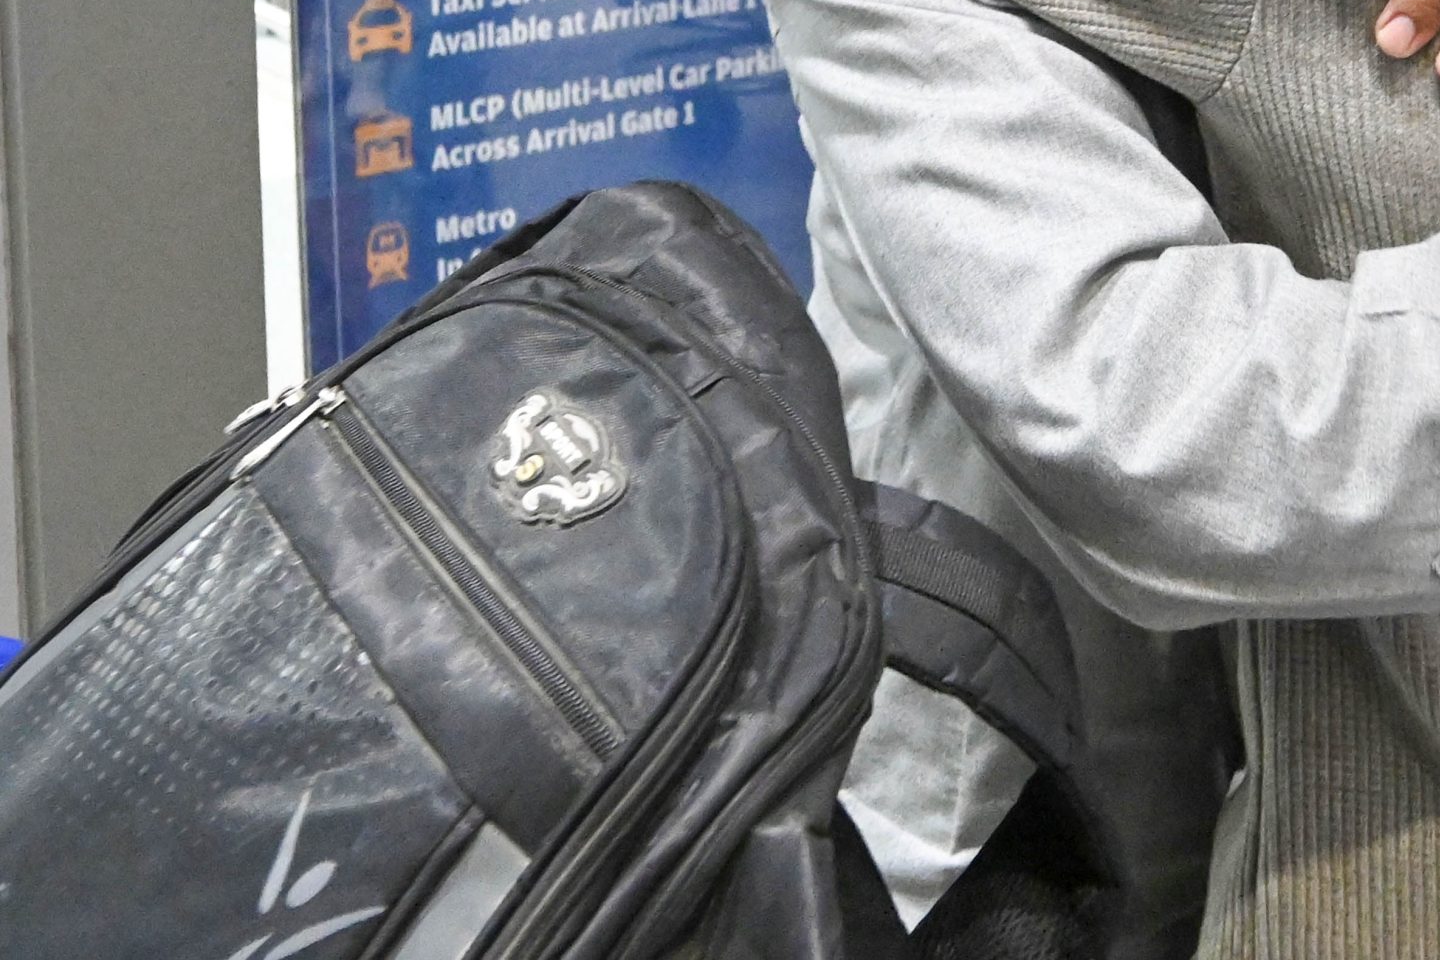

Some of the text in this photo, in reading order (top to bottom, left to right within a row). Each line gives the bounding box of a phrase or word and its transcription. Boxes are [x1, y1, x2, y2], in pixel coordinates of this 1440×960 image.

[427, 14, 553, 59] Available
[557, 10, 586, 40] at
[430, 94, 506, 132] MLCP
[511, 63, 665, 120] (Multi-Level
[669, 62, 712, 90] Car
[430, 100, 695, 173] Across Arrival Gate 1
[436, 206, 517, 245] Metro
